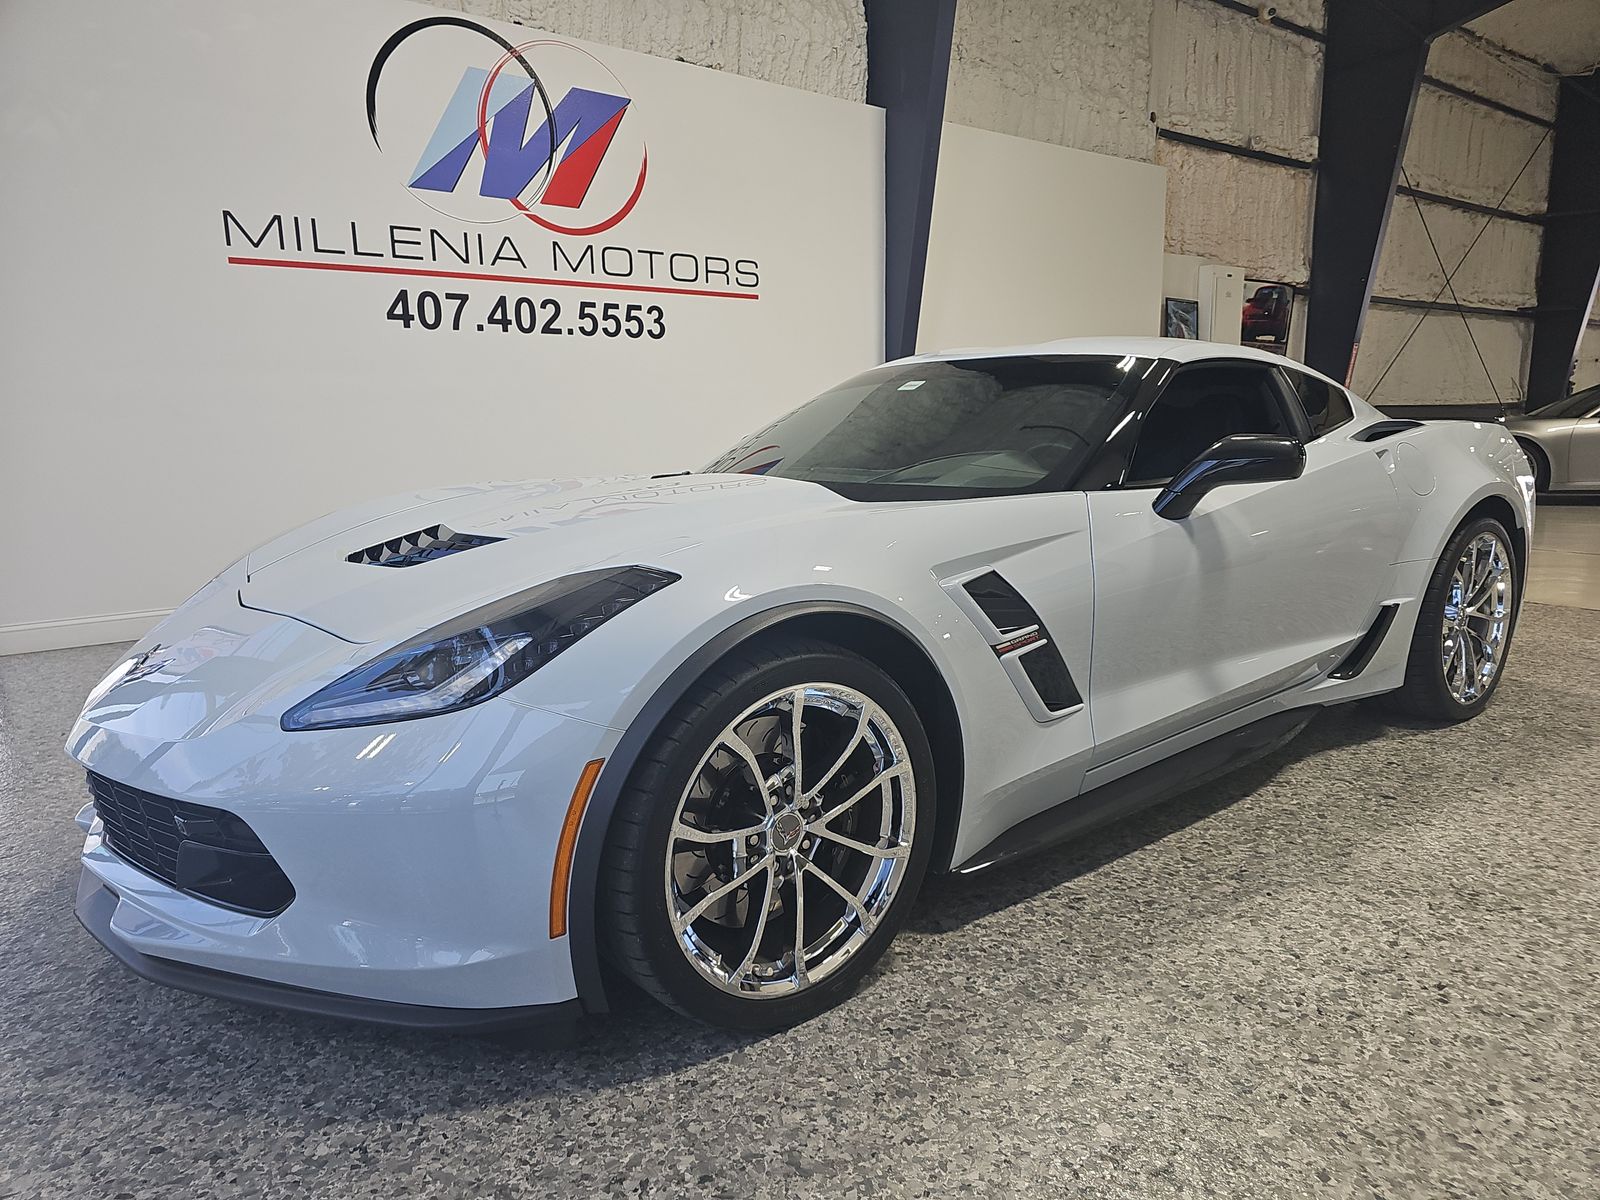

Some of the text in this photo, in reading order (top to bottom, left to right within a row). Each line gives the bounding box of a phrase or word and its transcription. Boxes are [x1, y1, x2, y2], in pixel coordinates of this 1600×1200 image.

[222, 209, 760, 289] MILLENIA MOTORS
[386, 289, 666, 340] 407.402.5553
